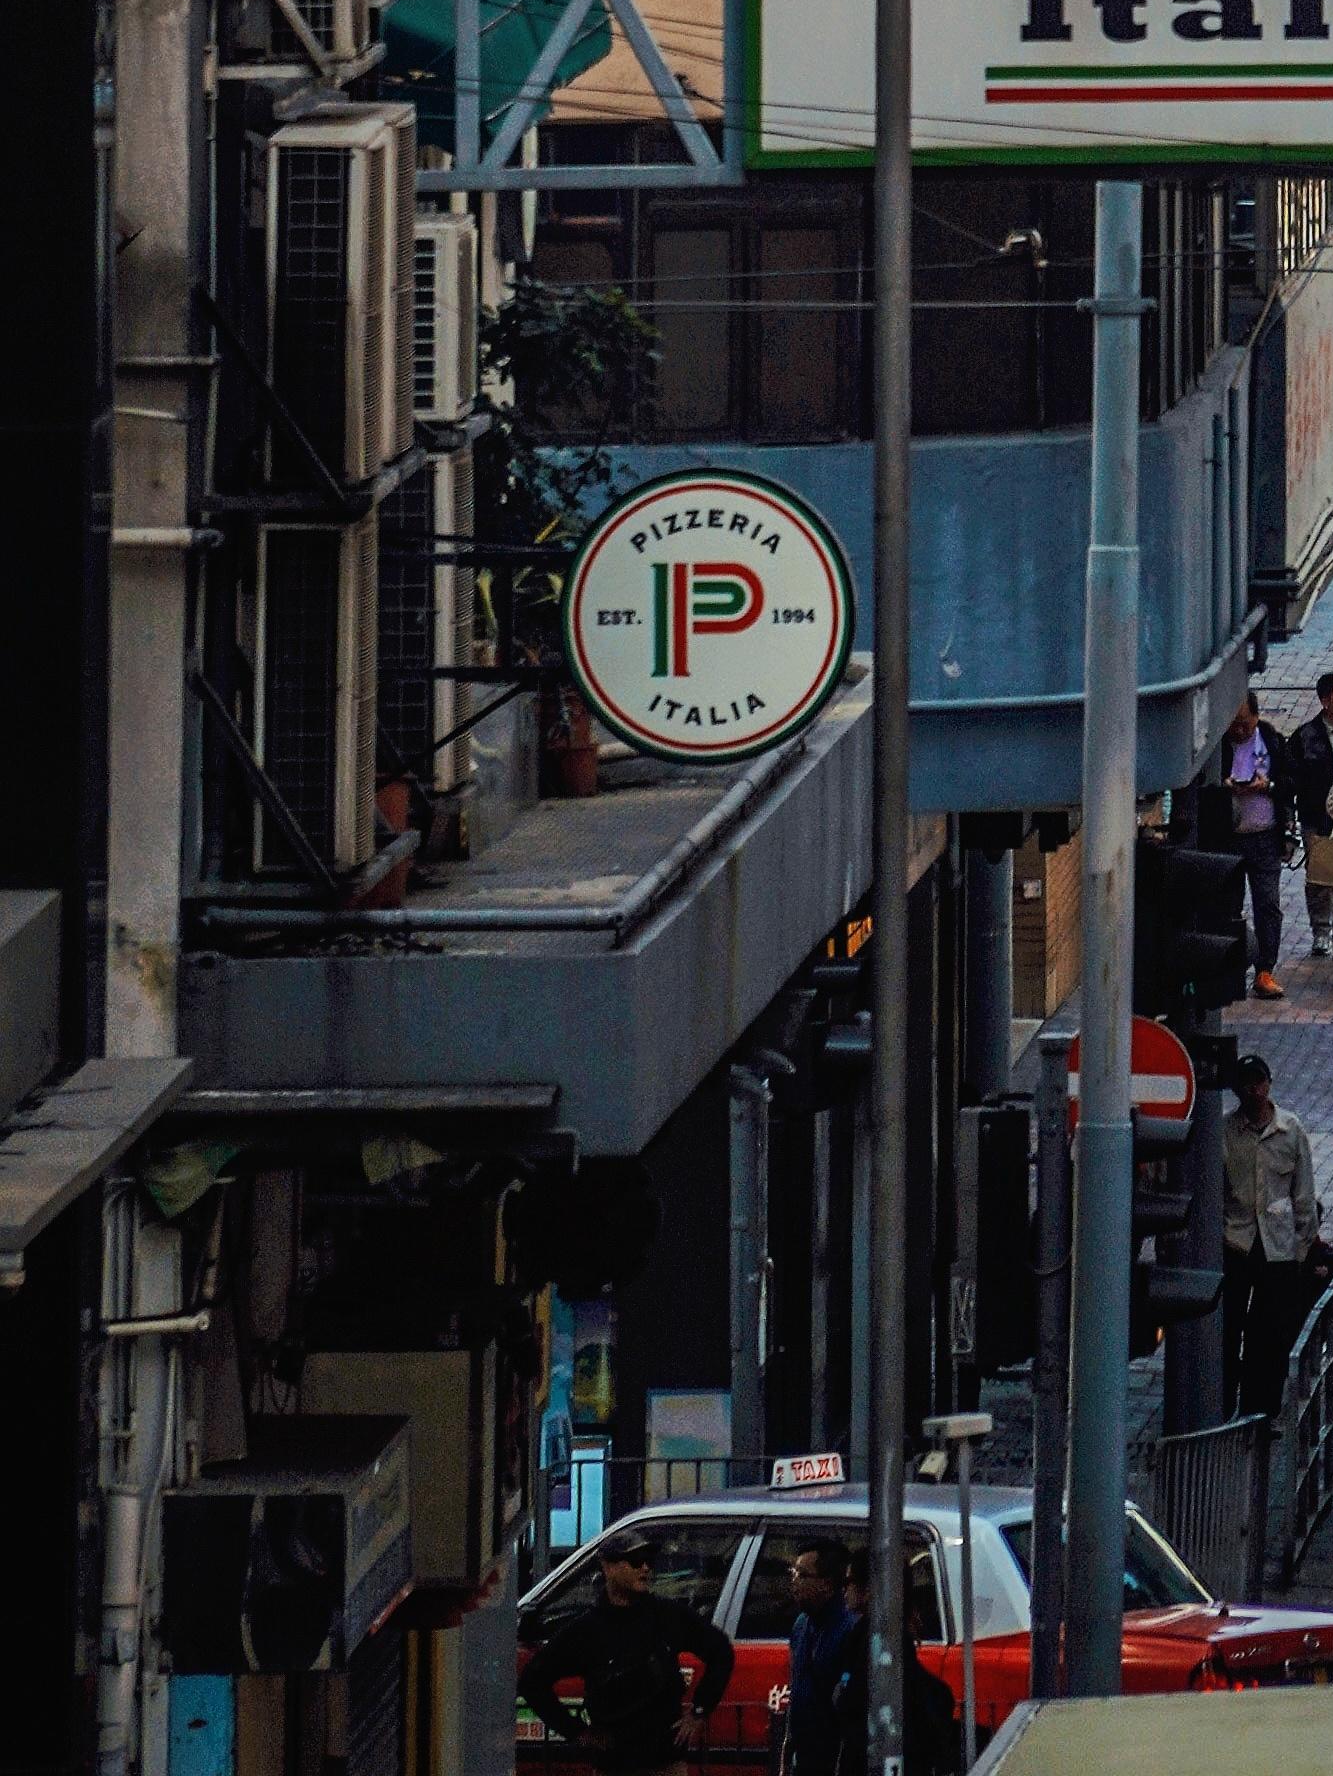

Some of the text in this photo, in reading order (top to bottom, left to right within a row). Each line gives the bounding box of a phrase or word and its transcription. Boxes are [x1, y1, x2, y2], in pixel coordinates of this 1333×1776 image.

[630, 508, 783, 555] PIZZERIA
[596, 608, 816, 626] EST. 1994
[648, 691, 766, 727] ITALIA
[790, 1456, 840, 1482] TAXI
